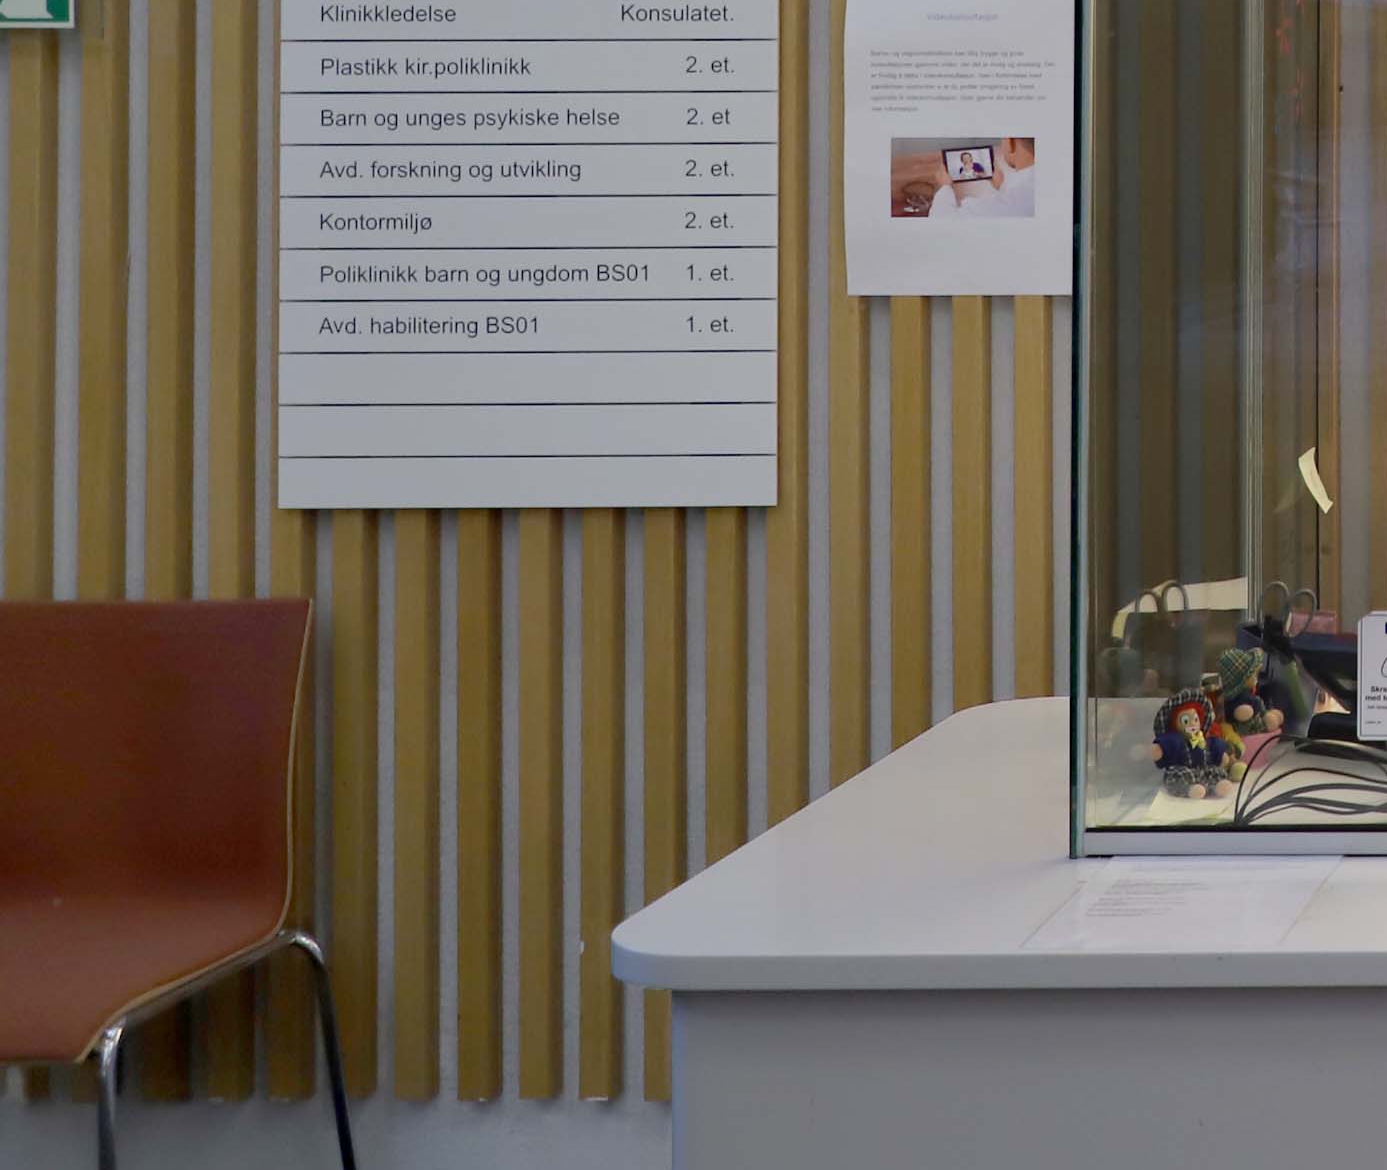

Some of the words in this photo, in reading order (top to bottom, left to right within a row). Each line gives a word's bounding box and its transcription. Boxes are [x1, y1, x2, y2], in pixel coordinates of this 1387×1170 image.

[320, 4, 457, 23] Klinikkledelse
[621, 3, 734, 23] Konsulatet.
[320, 57, 398, 77] Plastikk
[405, 56, 532, 80] kir.poliklinikk
[685, 55, 703, 74] 2.
[710, 56, 735, 74] et.
[320, 108, 367, 127] Barn
[373, 112, 399, 132] og
[405, 112, 467, 132] unges
[473, 107, 560, 131] psykiske
[566, 107, 620, 126] helse
[686, 107, 704, 126] 2.
[711, 108, 731, 126] et
[319, 160, 364, 179] Avd.
[369, 160, 462, 183] forskning
[468, 164, 493, 183] og
[500, 159, 582, 183] utvikling
[684, 158, 703, 178] 2.
[710, 159, 735, 177] et.
[319, 212, 433, 235] Kontormiljø
[684, 211, 702, 230] 2.
[709, 212, 734, 229] et.
[319, 264, 419, 284] Poliklinikk
[424, 264, 469, 284] barn
[475, 268, 501, 287] og
[507, 264, 589, 287] ungdom
[596, 263, 649, 282] BS01
[686, 263, 702, 282] 1.
[709, 264, 734, 282] et.
[318, 316, 363, 335] Avd.
[370, 316, 479, 339] habilitering
[485, 315, 538, 335] BS01
[686, 315, 703, 333] 1.
[709, 315, 734, 333] et.
